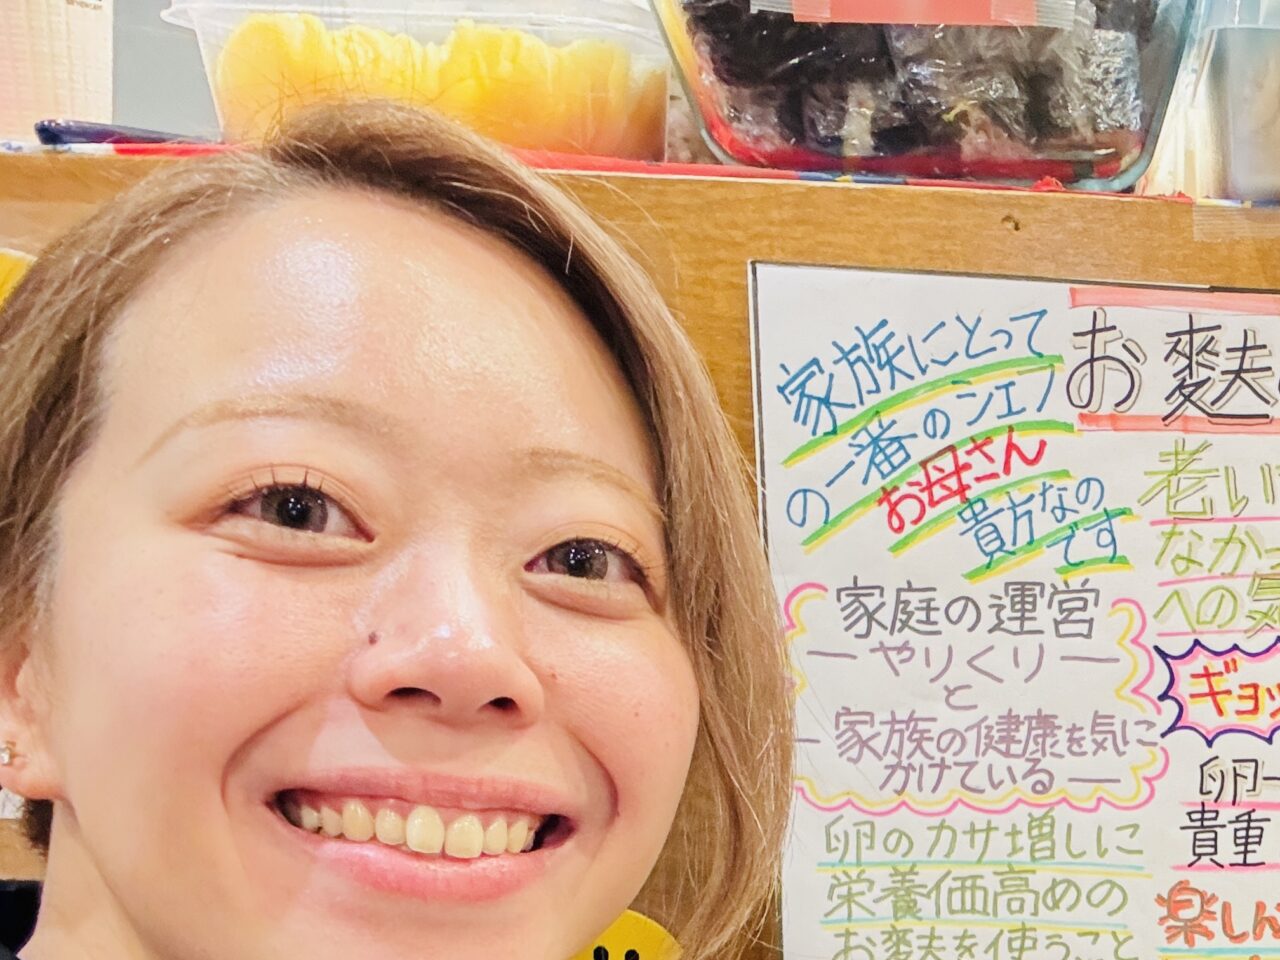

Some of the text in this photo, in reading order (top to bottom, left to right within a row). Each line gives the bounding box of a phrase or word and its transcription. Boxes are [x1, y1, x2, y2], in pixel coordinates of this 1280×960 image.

[777, 309, 1048, 437] 家族にとって
[876, 425, 1047, 533] お母さん
[957, 477, 1105, 569] 貴方なの
[835, 576, 1100, 639] 家庭の運営
[943, 684, 978, 711] と
[834, 706, 1160, 764] 家族の健康を気に
[824, 807, 1144, 867] 卵のカサ増しに
[823, 863, 1129, 922] 栄養価高めの
